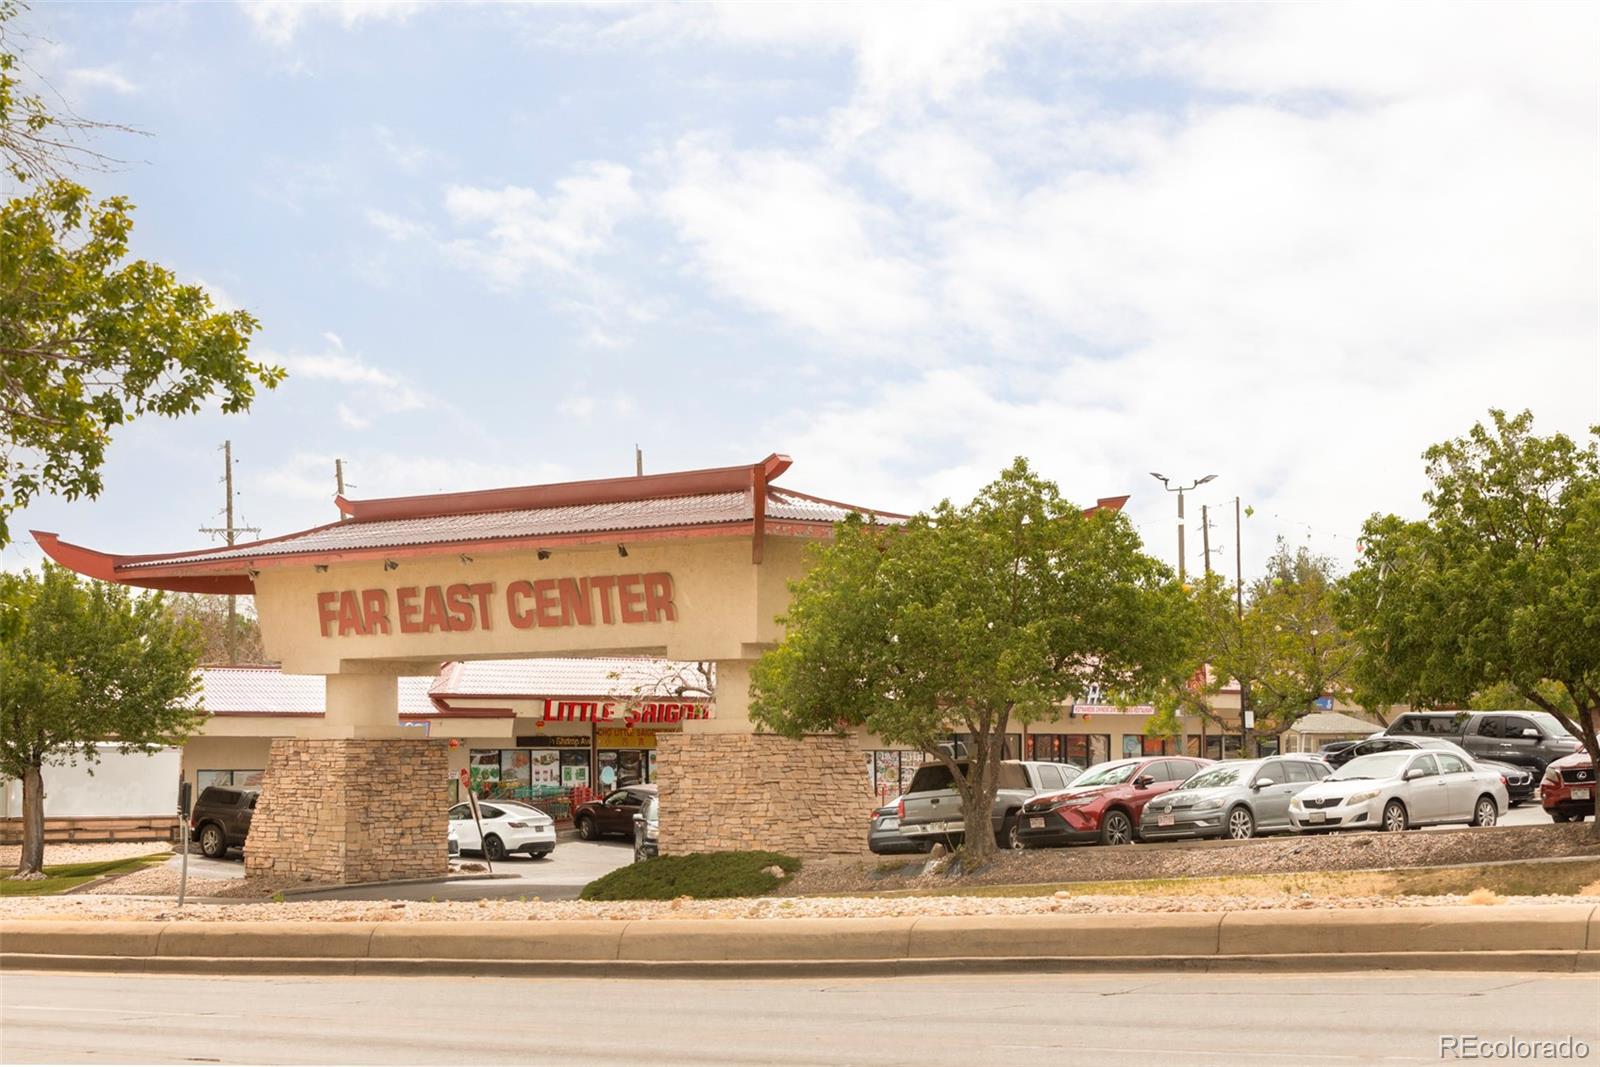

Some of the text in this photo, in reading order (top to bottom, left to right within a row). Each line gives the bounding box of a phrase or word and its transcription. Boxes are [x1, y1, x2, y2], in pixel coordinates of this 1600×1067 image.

[316, 572, 677, 638] FAR EAST CENTER
[543, 699, 709, 724] LITTLE SAIGON
